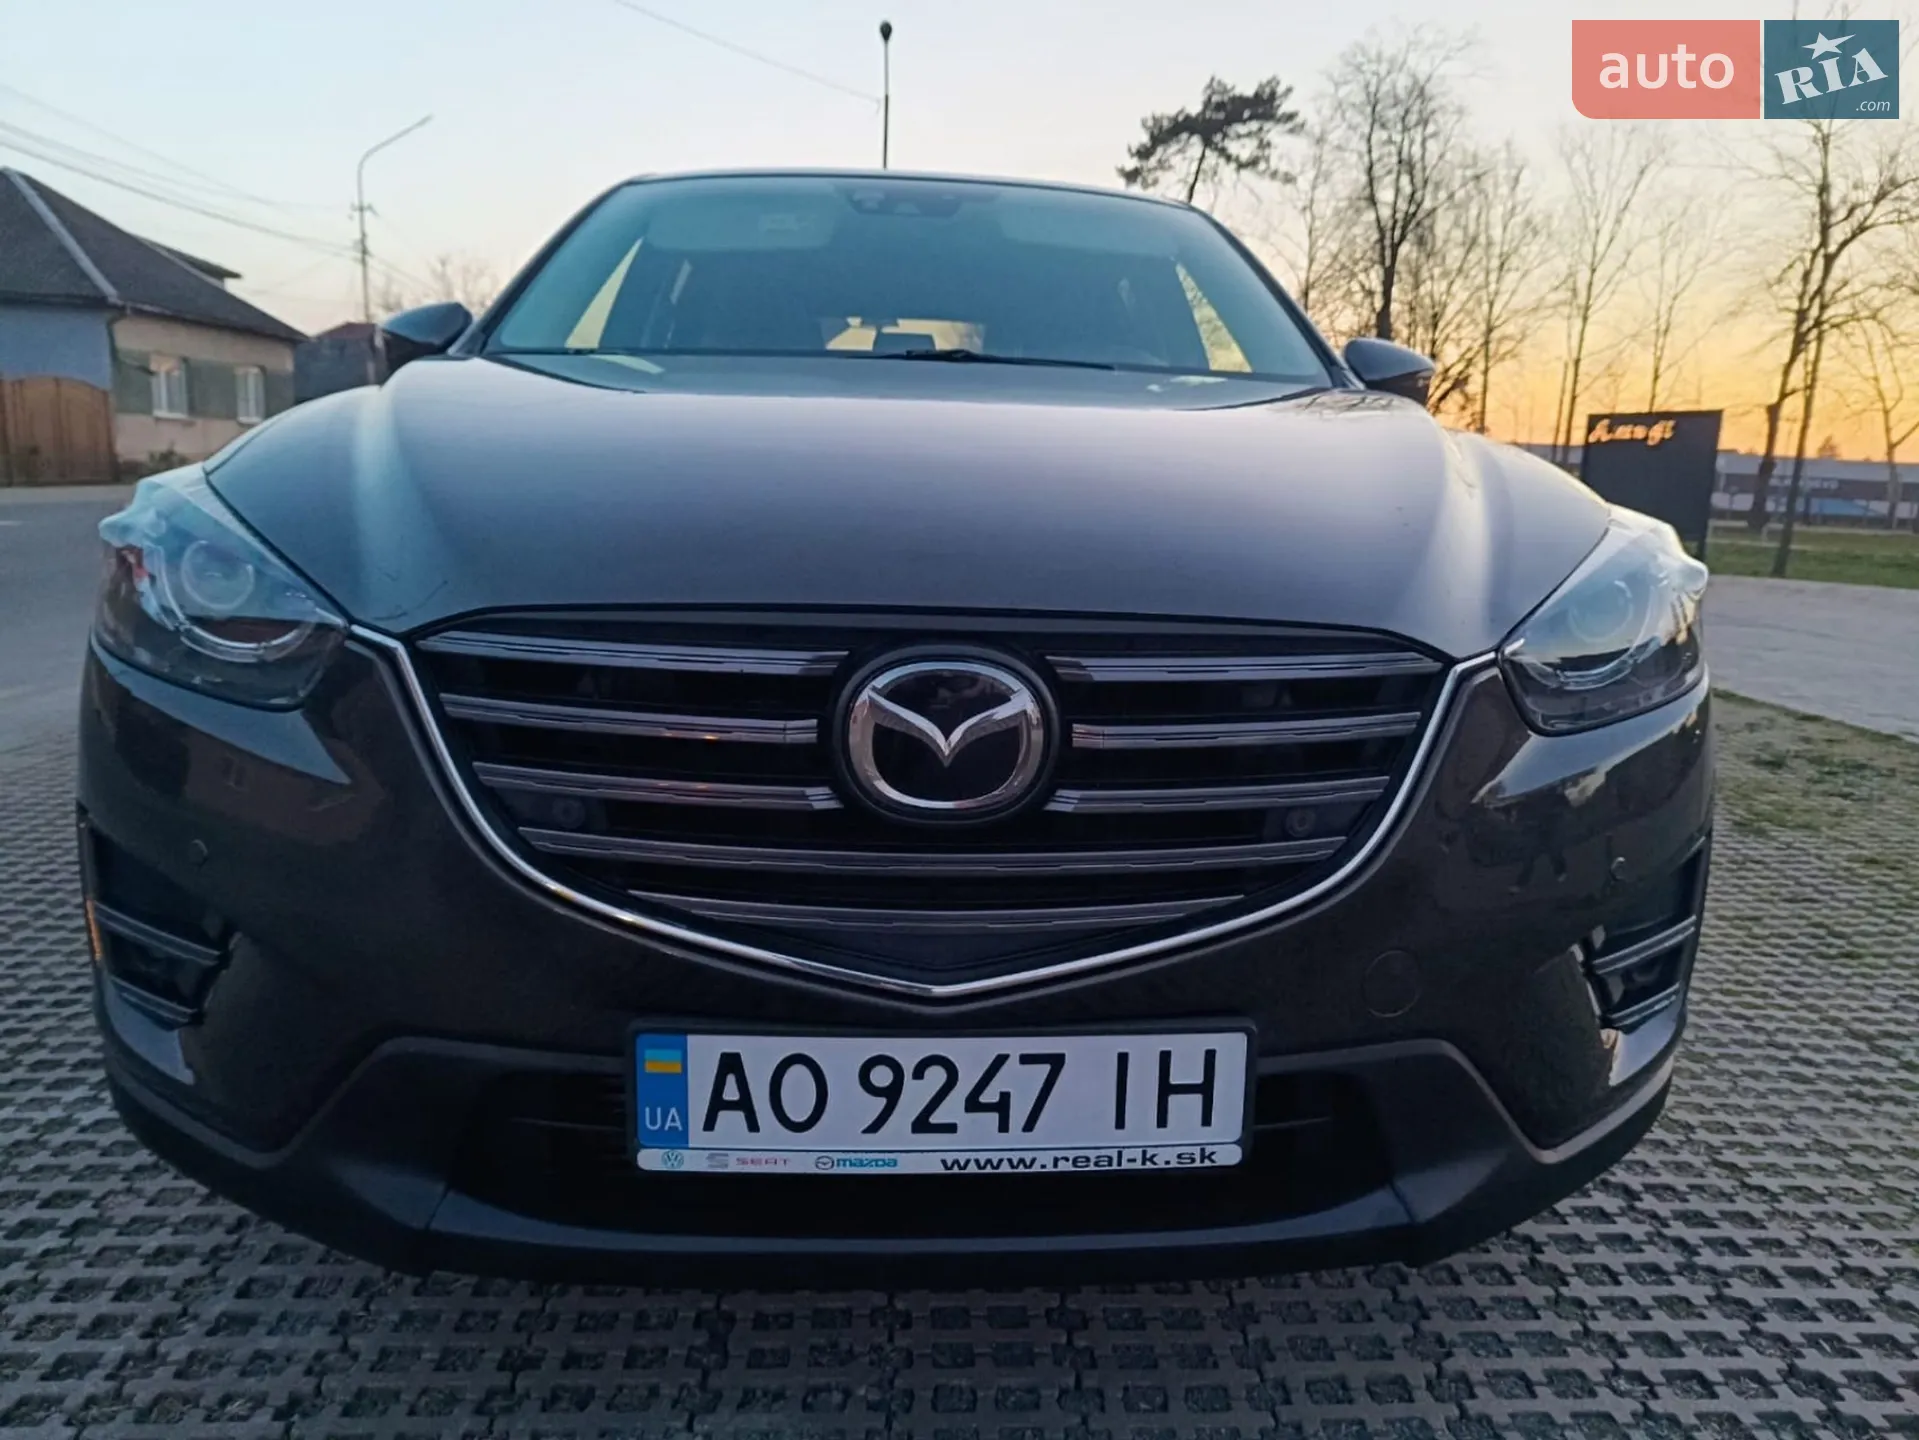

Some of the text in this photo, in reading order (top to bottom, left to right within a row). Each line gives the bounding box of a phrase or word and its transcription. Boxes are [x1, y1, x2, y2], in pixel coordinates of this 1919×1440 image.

[702, 1049, 1217, 1134] AO 9247 IH
[645, 1107, 683, 1131] UA
[736, 1157, 791, 1167] SEAT
[940, 1147, 1217, 1170] www.real-k.sk
